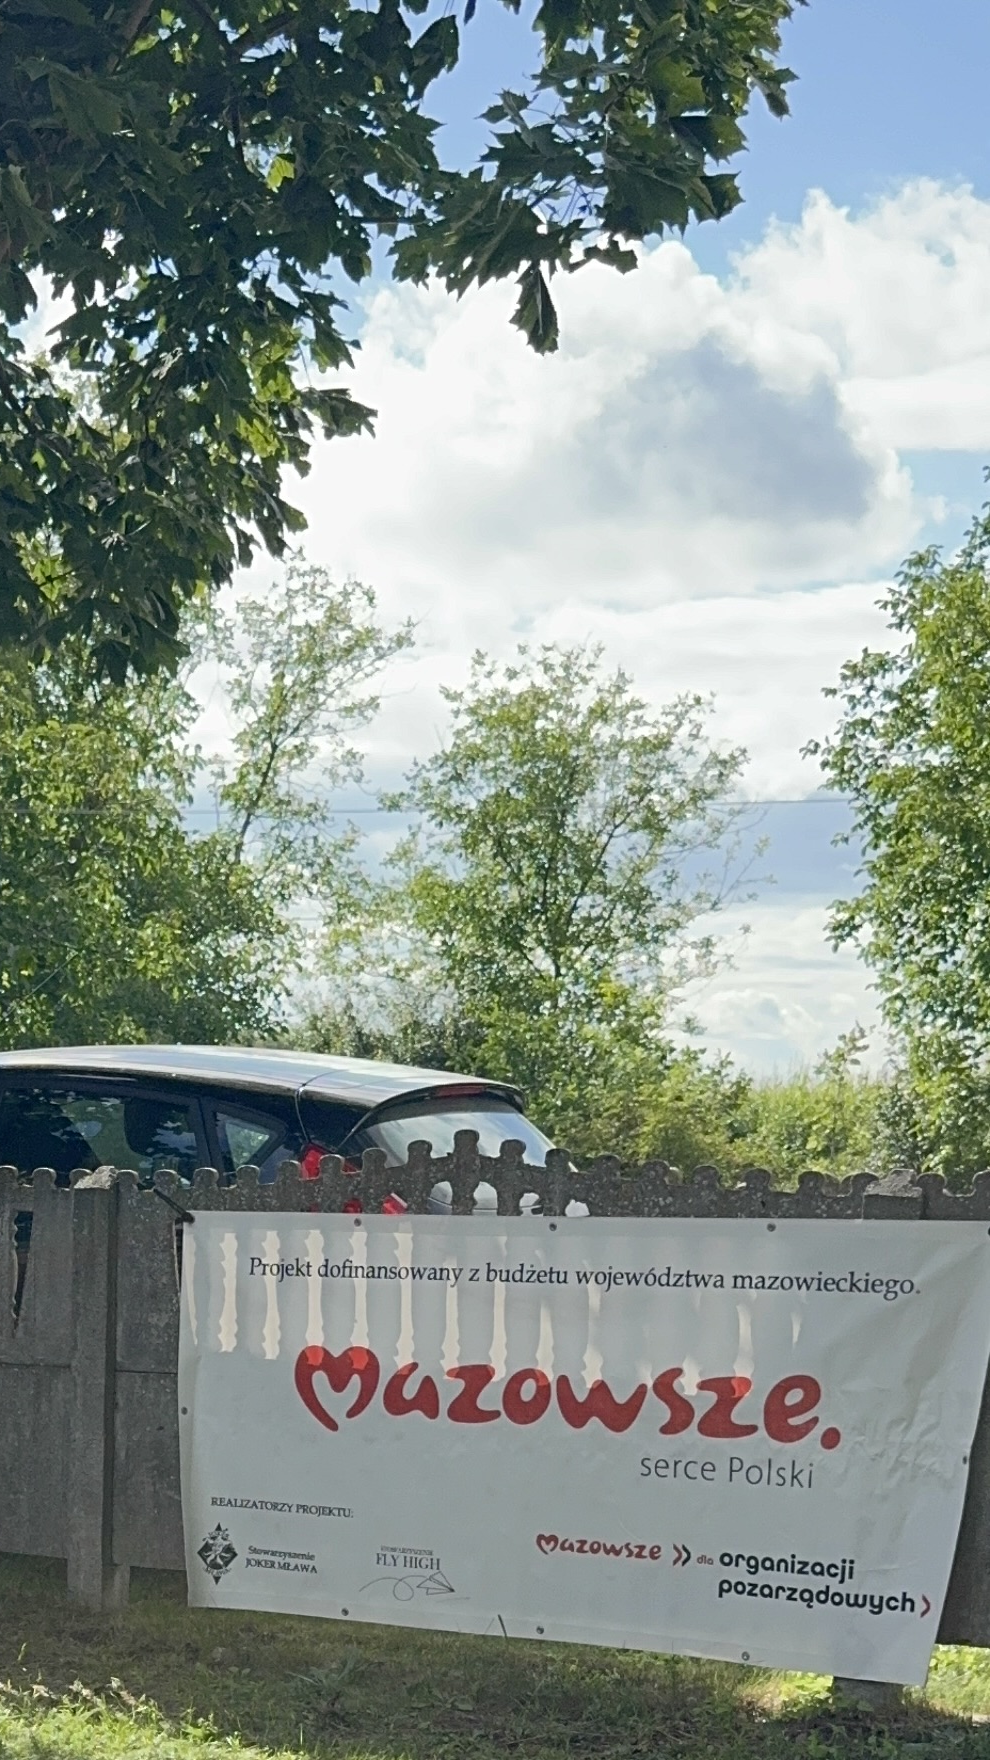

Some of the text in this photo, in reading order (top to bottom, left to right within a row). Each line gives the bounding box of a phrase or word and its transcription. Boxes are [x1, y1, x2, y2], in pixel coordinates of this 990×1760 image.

[249, 1257, 921, 1301] Projekt dofinansowany z budżetu województwa mazowieckiego.
[293, 1345, 841, 1450] Mazowsze.
[640, 1455, 814, 1489] serce Polski
[210, 1497, 354, 1518] REALIZATORZY PROJEKTU:
[245, 1557, 276, 1571] JOKER
[248, 1546, 316, 1561] Stowarzyszenie
[376, 1552, 440, 1570] FLY HIGH
[536, 1533, 855, 1580] Mazowsze dla organizacji
[717, 1577, 915, 1615] pozarządowych
